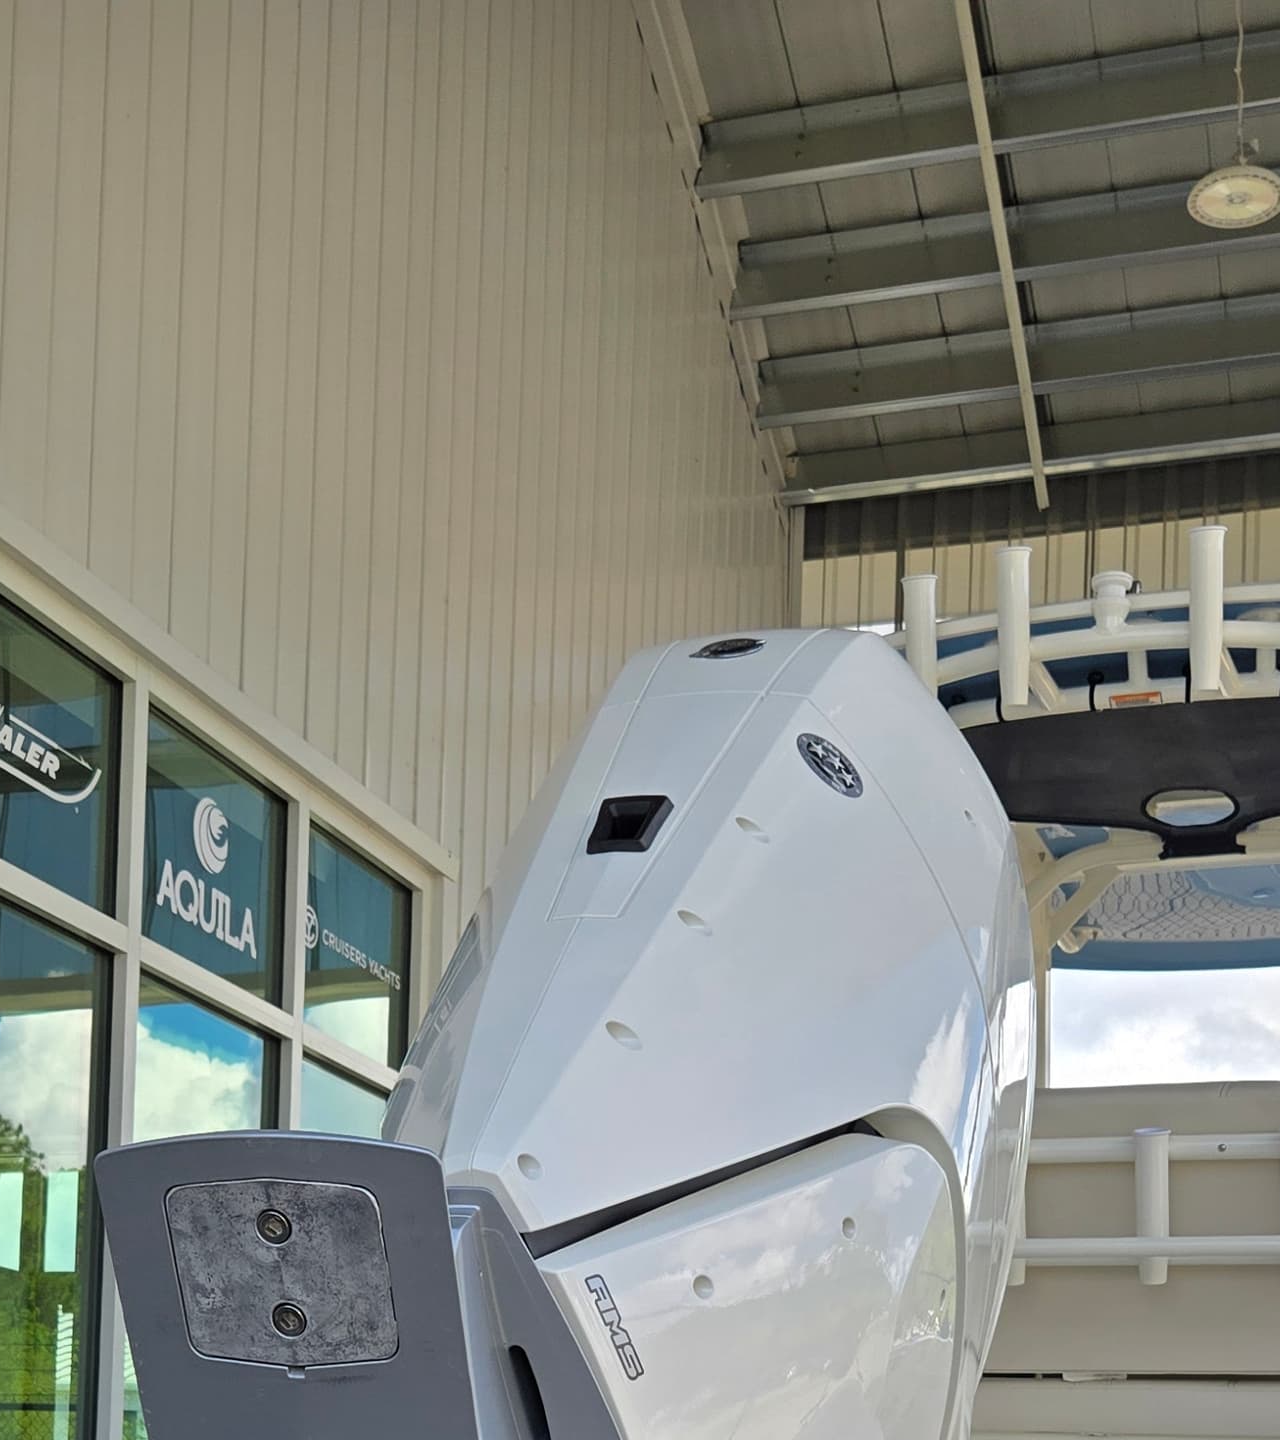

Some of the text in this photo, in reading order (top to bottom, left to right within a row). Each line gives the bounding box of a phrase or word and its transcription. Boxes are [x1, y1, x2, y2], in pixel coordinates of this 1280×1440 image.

[156, 858, 257, 960] AQUILA
[322, 928, 401, 991] CRUISERS YACHTS
[584, 1273, 645, 1381] AMS
